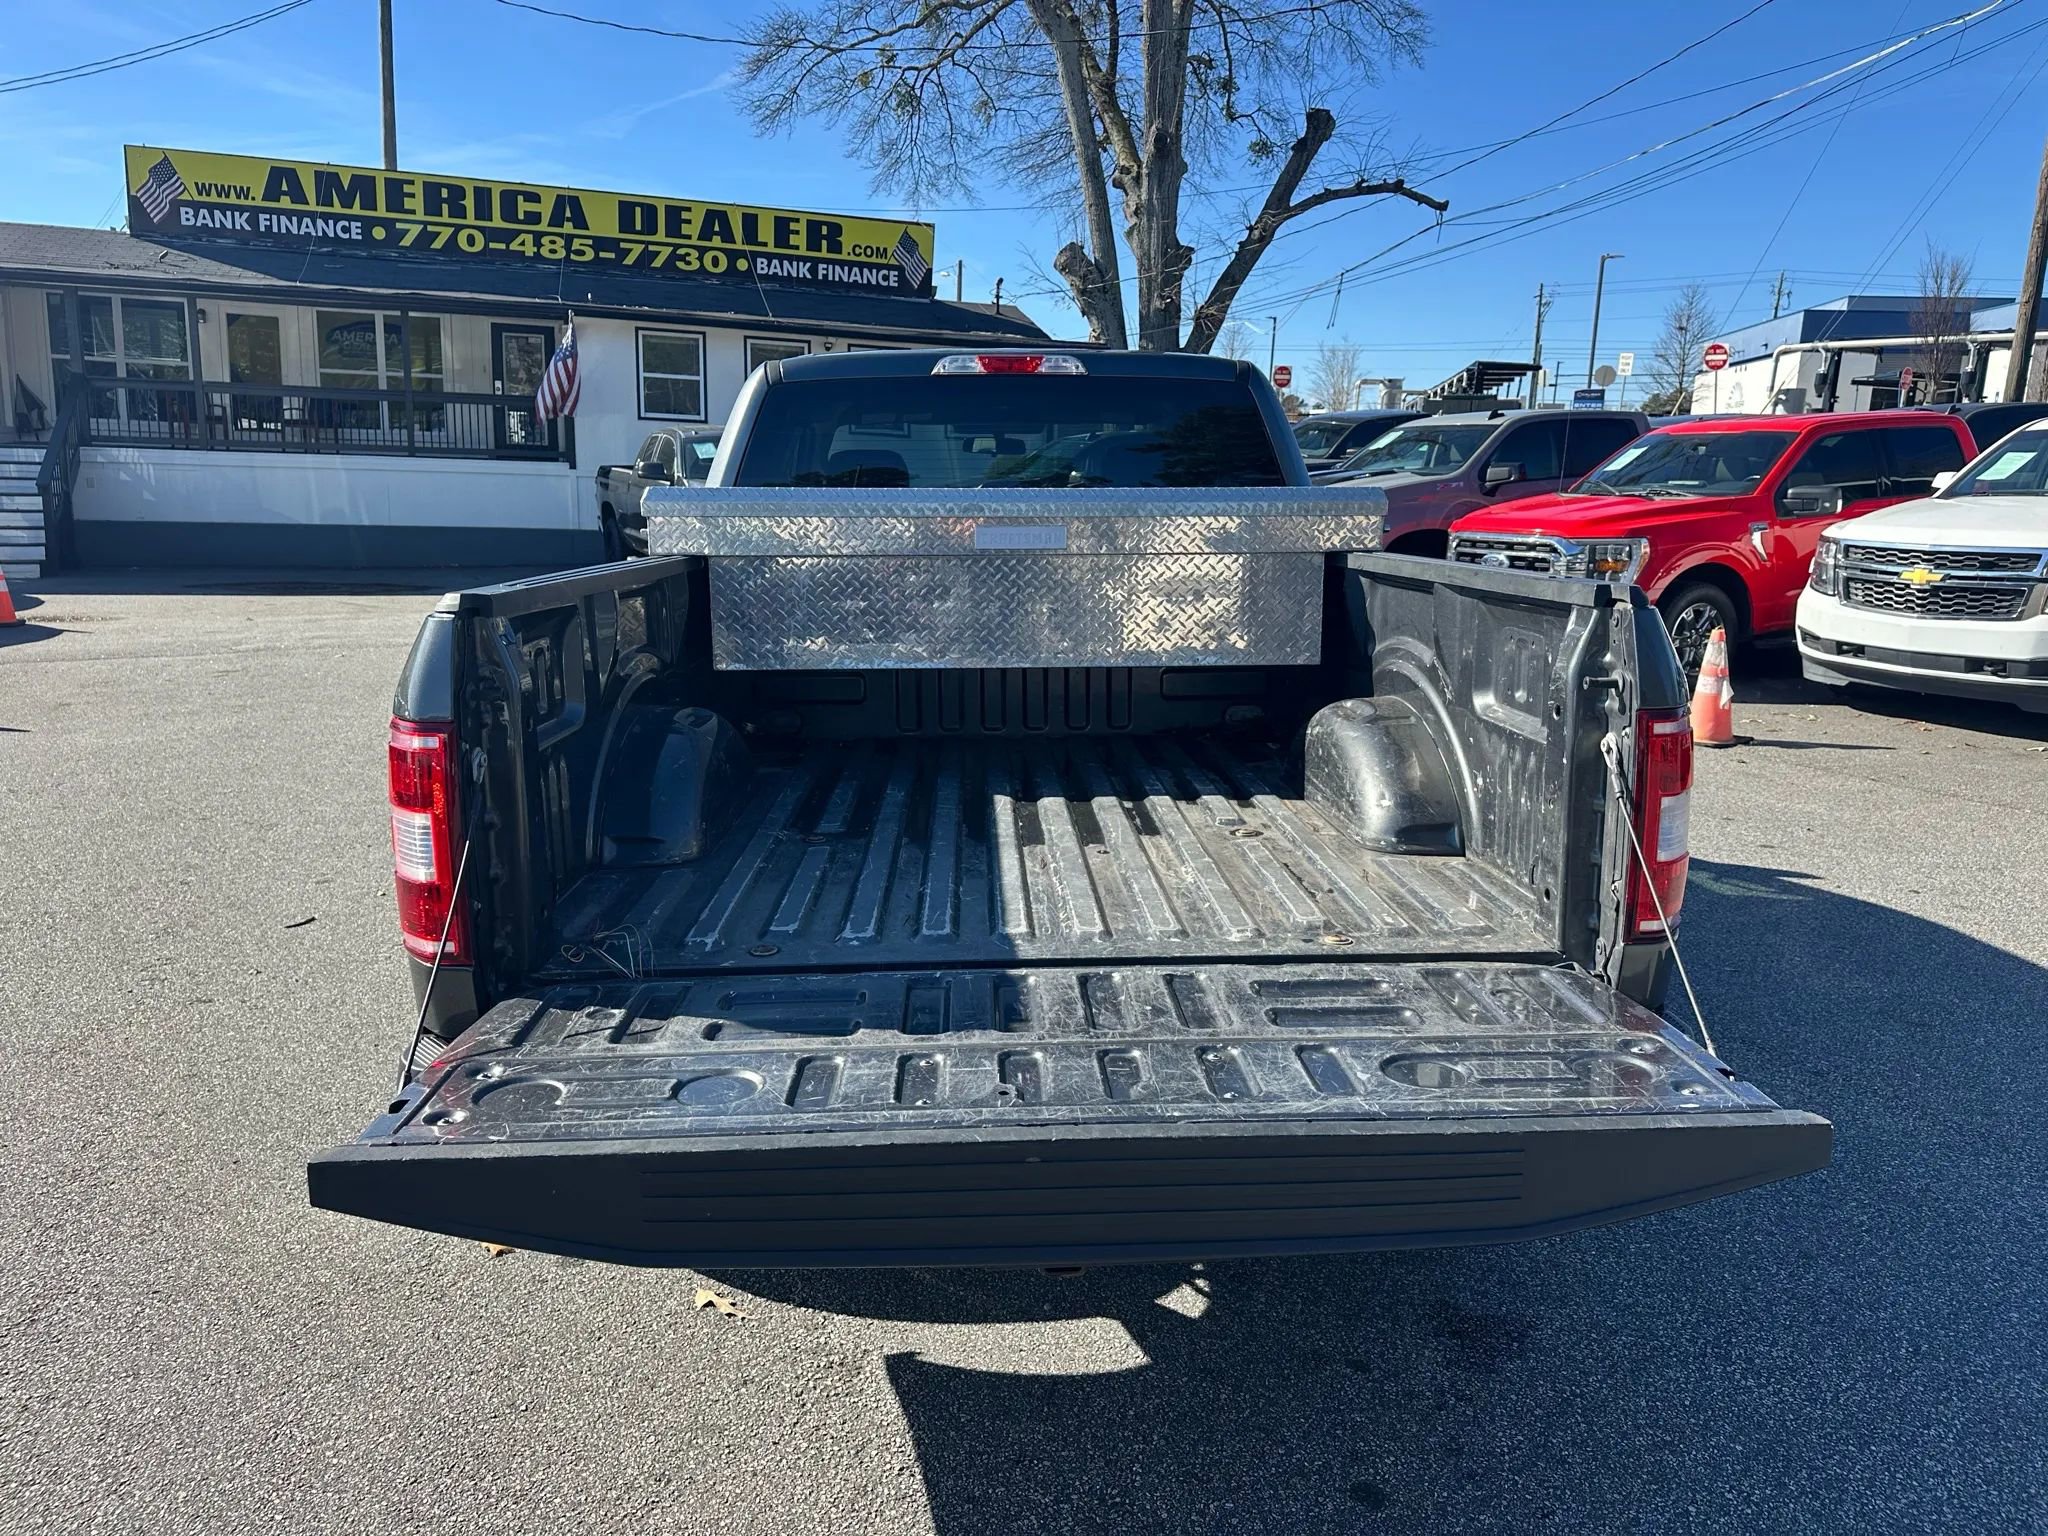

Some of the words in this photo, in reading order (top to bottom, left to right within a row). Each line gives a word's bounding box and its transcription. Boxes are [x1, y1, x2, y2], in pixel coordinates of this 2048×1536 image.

[180, 206, 251, 231] BANK
[258, 213, 363, 241] FINANCE
[395, 222, 728, 273] 770-485-7730
[756, 257, 813, 280] BANK
[817, 264, 899, 287] FINANCE
[618, 199, 843, 255] DEALER
[980, 531, 1065, 546] CRAFTSMAN
